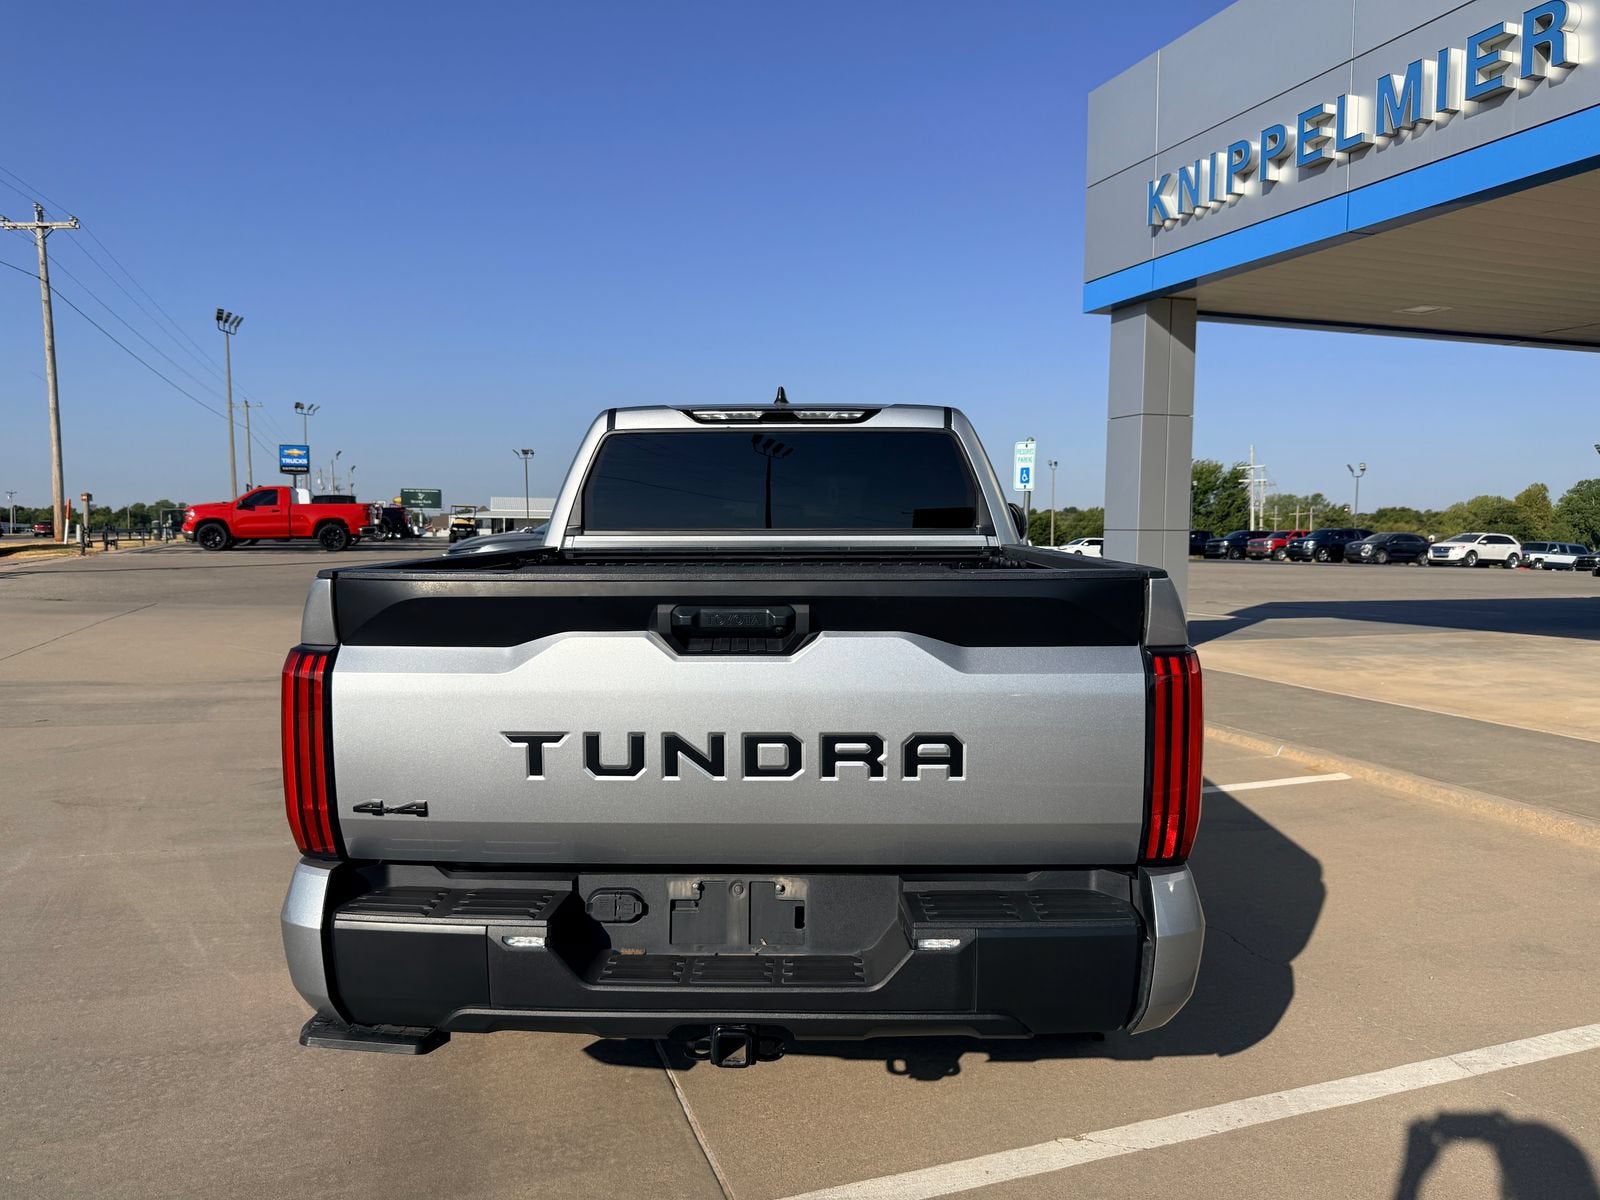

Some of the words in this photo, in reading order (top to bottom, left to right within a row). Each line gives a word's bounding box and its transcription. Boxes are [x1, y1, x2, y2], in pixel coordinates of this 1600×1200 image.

[1147, 0, 1576, 227] KNIPPELMIER
[705, 614, 762, 626] TOYOTA
[500, 731, 966, 782] TUNDRA
